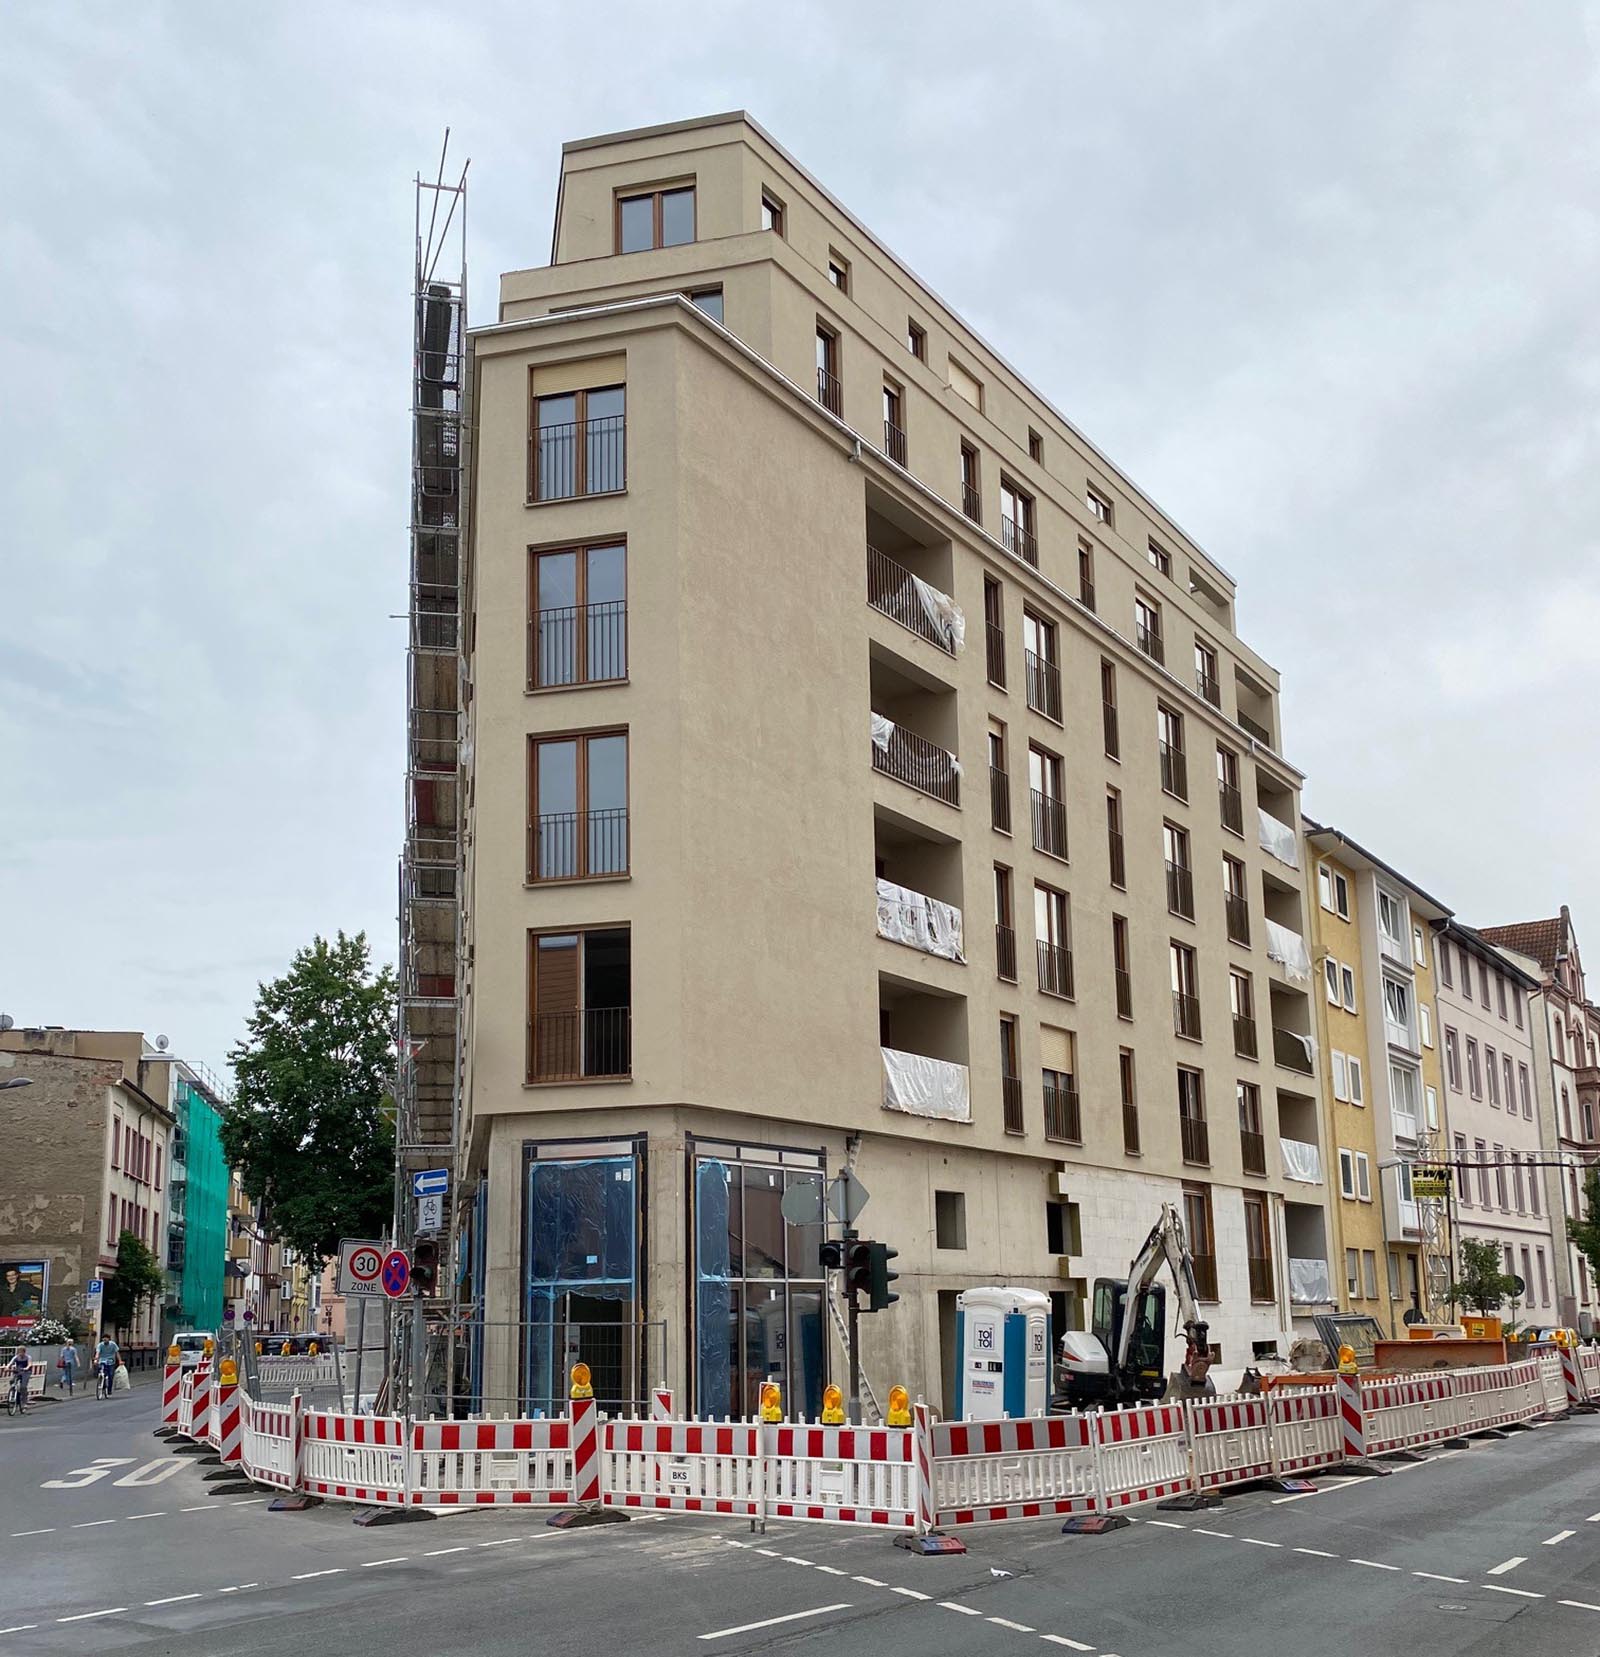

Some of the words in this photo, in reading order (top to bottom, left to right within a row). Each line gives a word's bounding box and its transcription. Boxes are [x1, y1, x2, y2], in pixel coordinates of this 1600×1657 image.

[356, 1257, 376, 1272] 30
[351, 1282, 377, 1292] ZONE
[40, 1457, 197, 1488] 30
[672, 1471, 688, 1480] BKS
